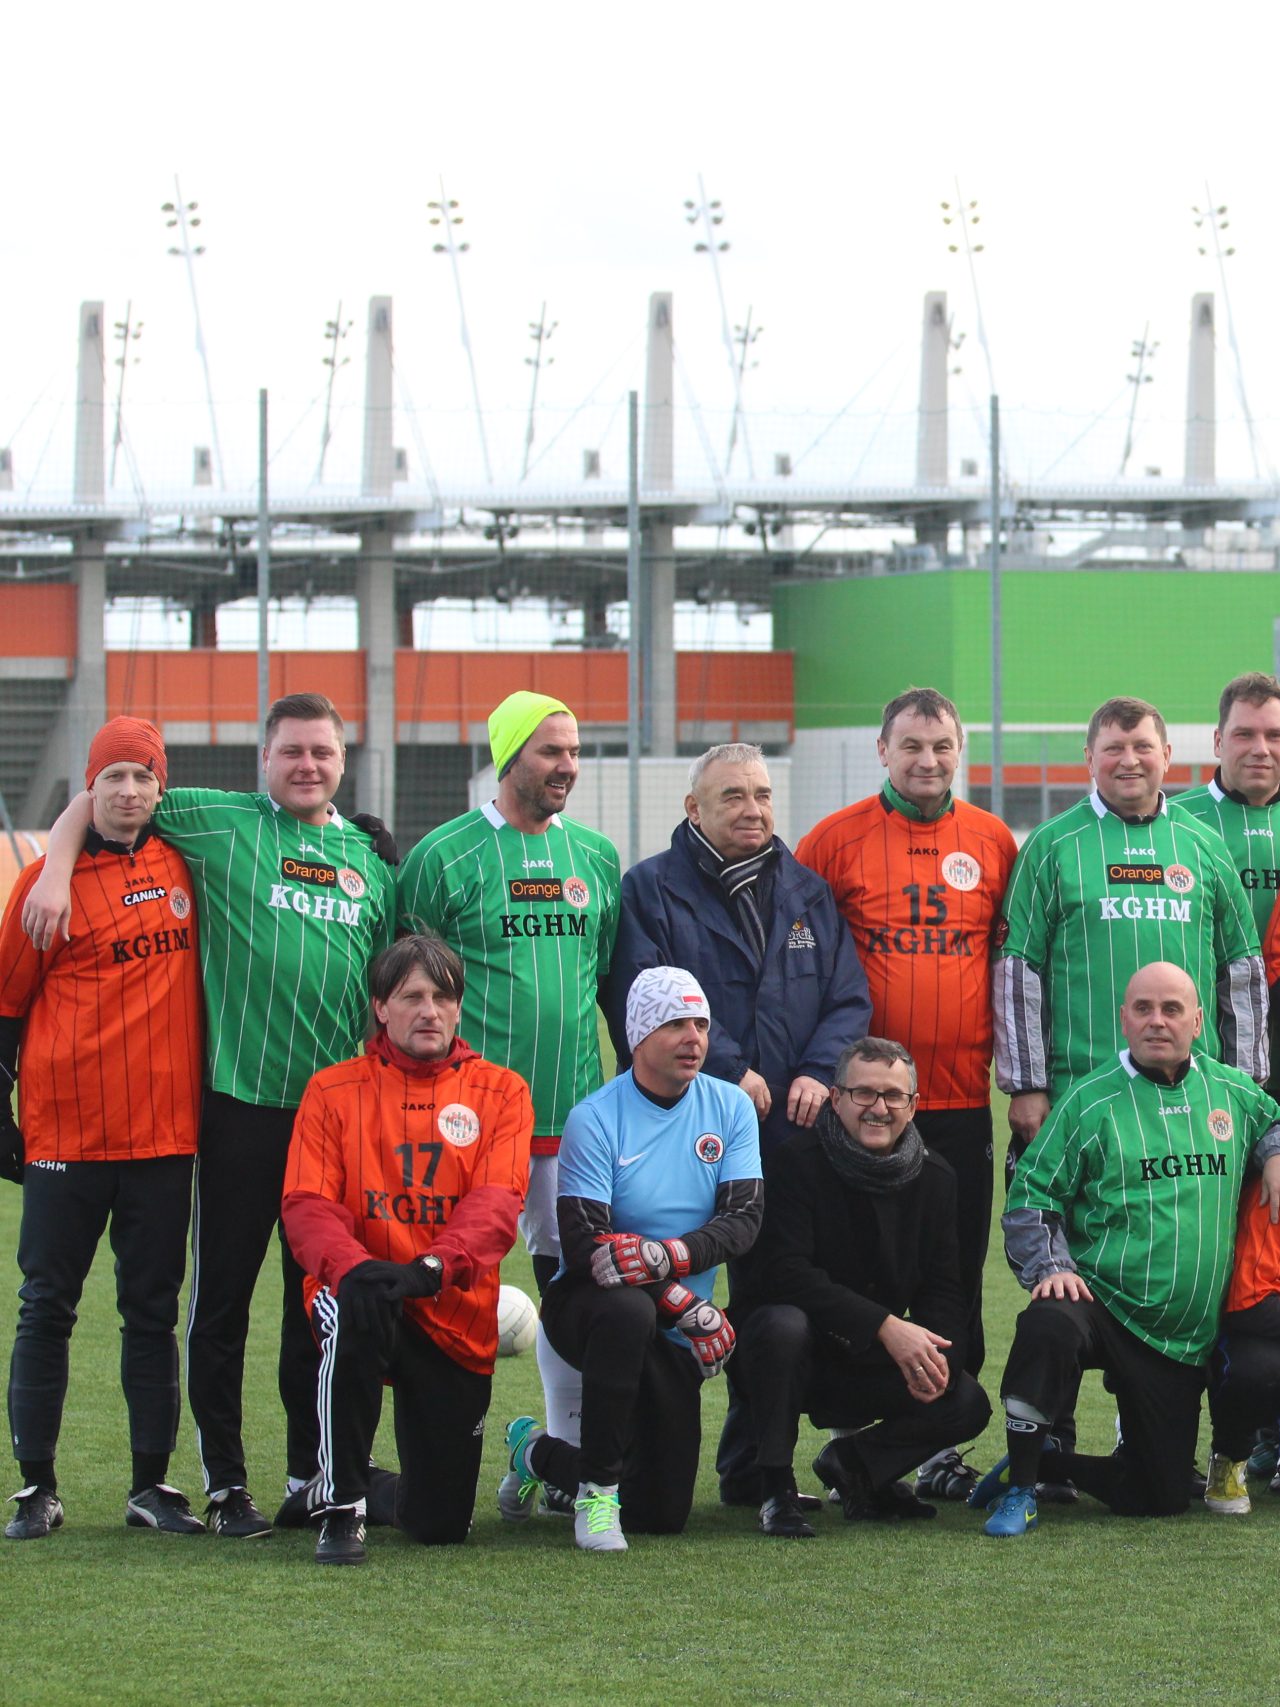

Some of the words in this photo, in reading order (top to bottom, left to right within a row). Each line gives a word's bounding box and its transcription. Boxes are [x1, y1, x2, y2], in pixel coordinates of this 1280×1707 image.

[1243, 828, 1274, 837] JAKO
[906, 847, 939, 856] JAKO
[1123, 847, 1156, 856] JAKO
[283, 860, 336, 883] Orange
[522, 859, 554, 868] JAKO
[1109, 866, 1162, 882] Orange
[124, 876, 155, 889] JAKO
[511, 881, 561, 898] Orange
[124, 887, 166, 906] CANAL+
[268, 884, 362, 926] KGHM
[902, 884, 947, 926] 15
[1099, 896, 1192, 922] KGHM
[499, 913, 588, 938] KGHM
[111, 927, 190, 964] KGHM
[863, 927, 973, 957] KGHM
[401, 1103, 436, 1111] JAKO
[1159, 1105, 1191, 1115] JAKO
[395, 1141, 444, 1188] 17
[1138, 1153, 1228, 1181] KGHM
[364, 1189, 460, 1225] KGH
